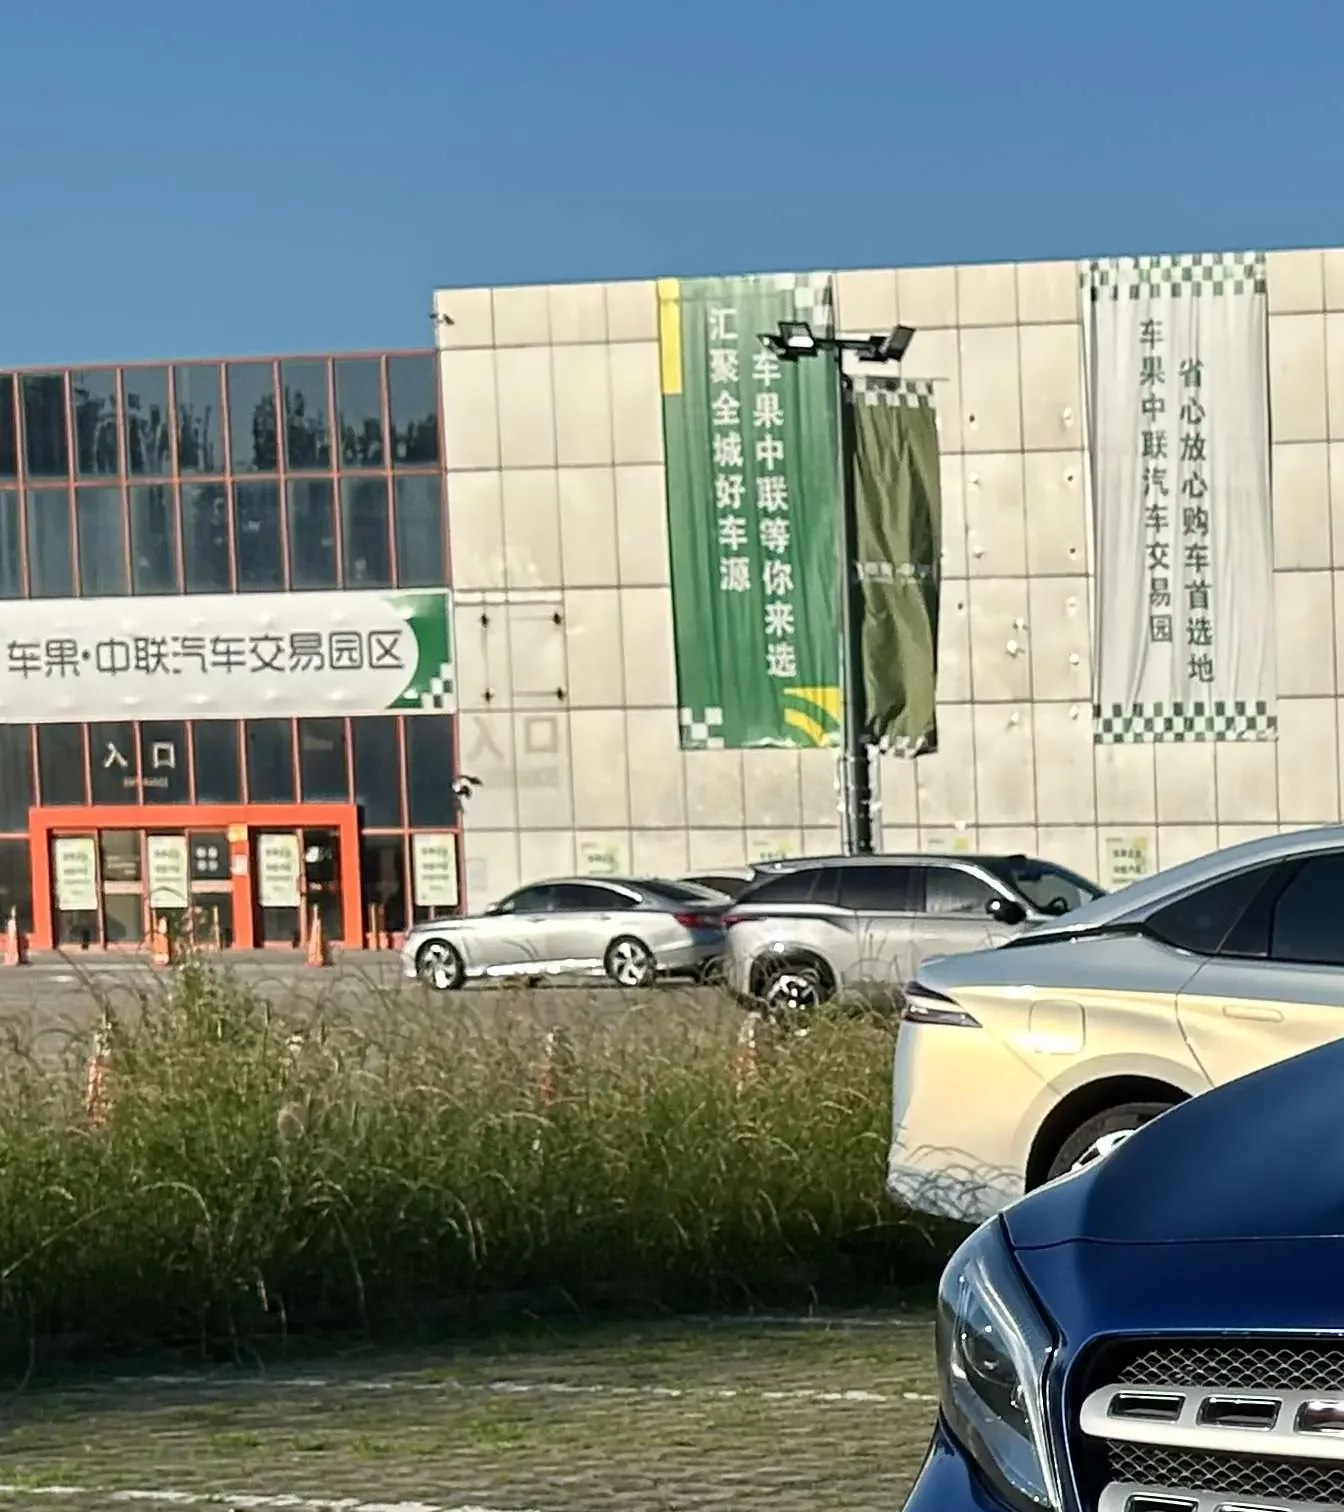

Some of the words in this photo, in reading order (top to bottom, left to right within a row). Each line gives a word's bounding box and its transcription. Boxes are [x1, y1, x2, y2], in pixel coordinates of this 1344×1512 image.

[709, 307, 751, 593] 汇聚全城好车源
[752, 352, 798, 678] 车果中联等你来选
[1139, 318, 1173, 643] 车果中联汽车交易园
[1178, 358, 1215, 683] 省心放心购车首选地
[7, 630, 405, 678] 车果·中联汽车交易园区
[104, 741, 177, 769] 入口
